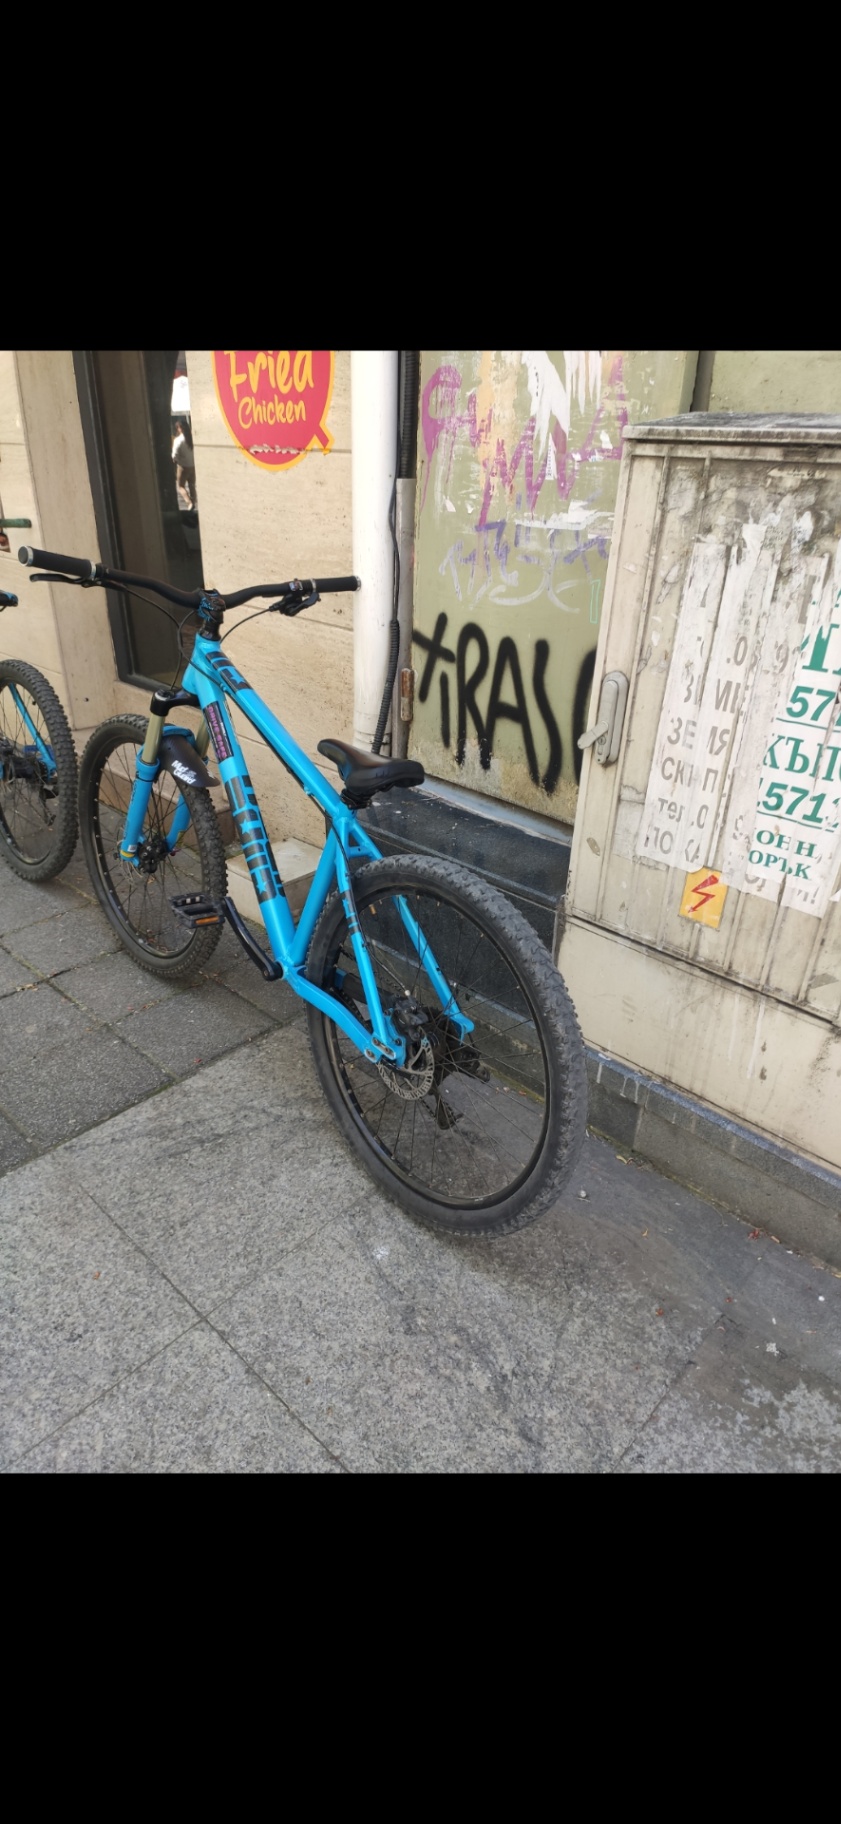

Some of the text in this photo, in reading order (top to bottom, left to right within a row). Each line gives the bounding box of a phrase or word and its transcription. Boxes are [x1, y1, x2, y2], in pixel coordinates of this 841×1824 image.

[223, 350, 314, 403] Fried
[238, 394, 306, 429] Chicken
[786, 686, 841, 728] 57
[757, 778, 841, 828] 571
